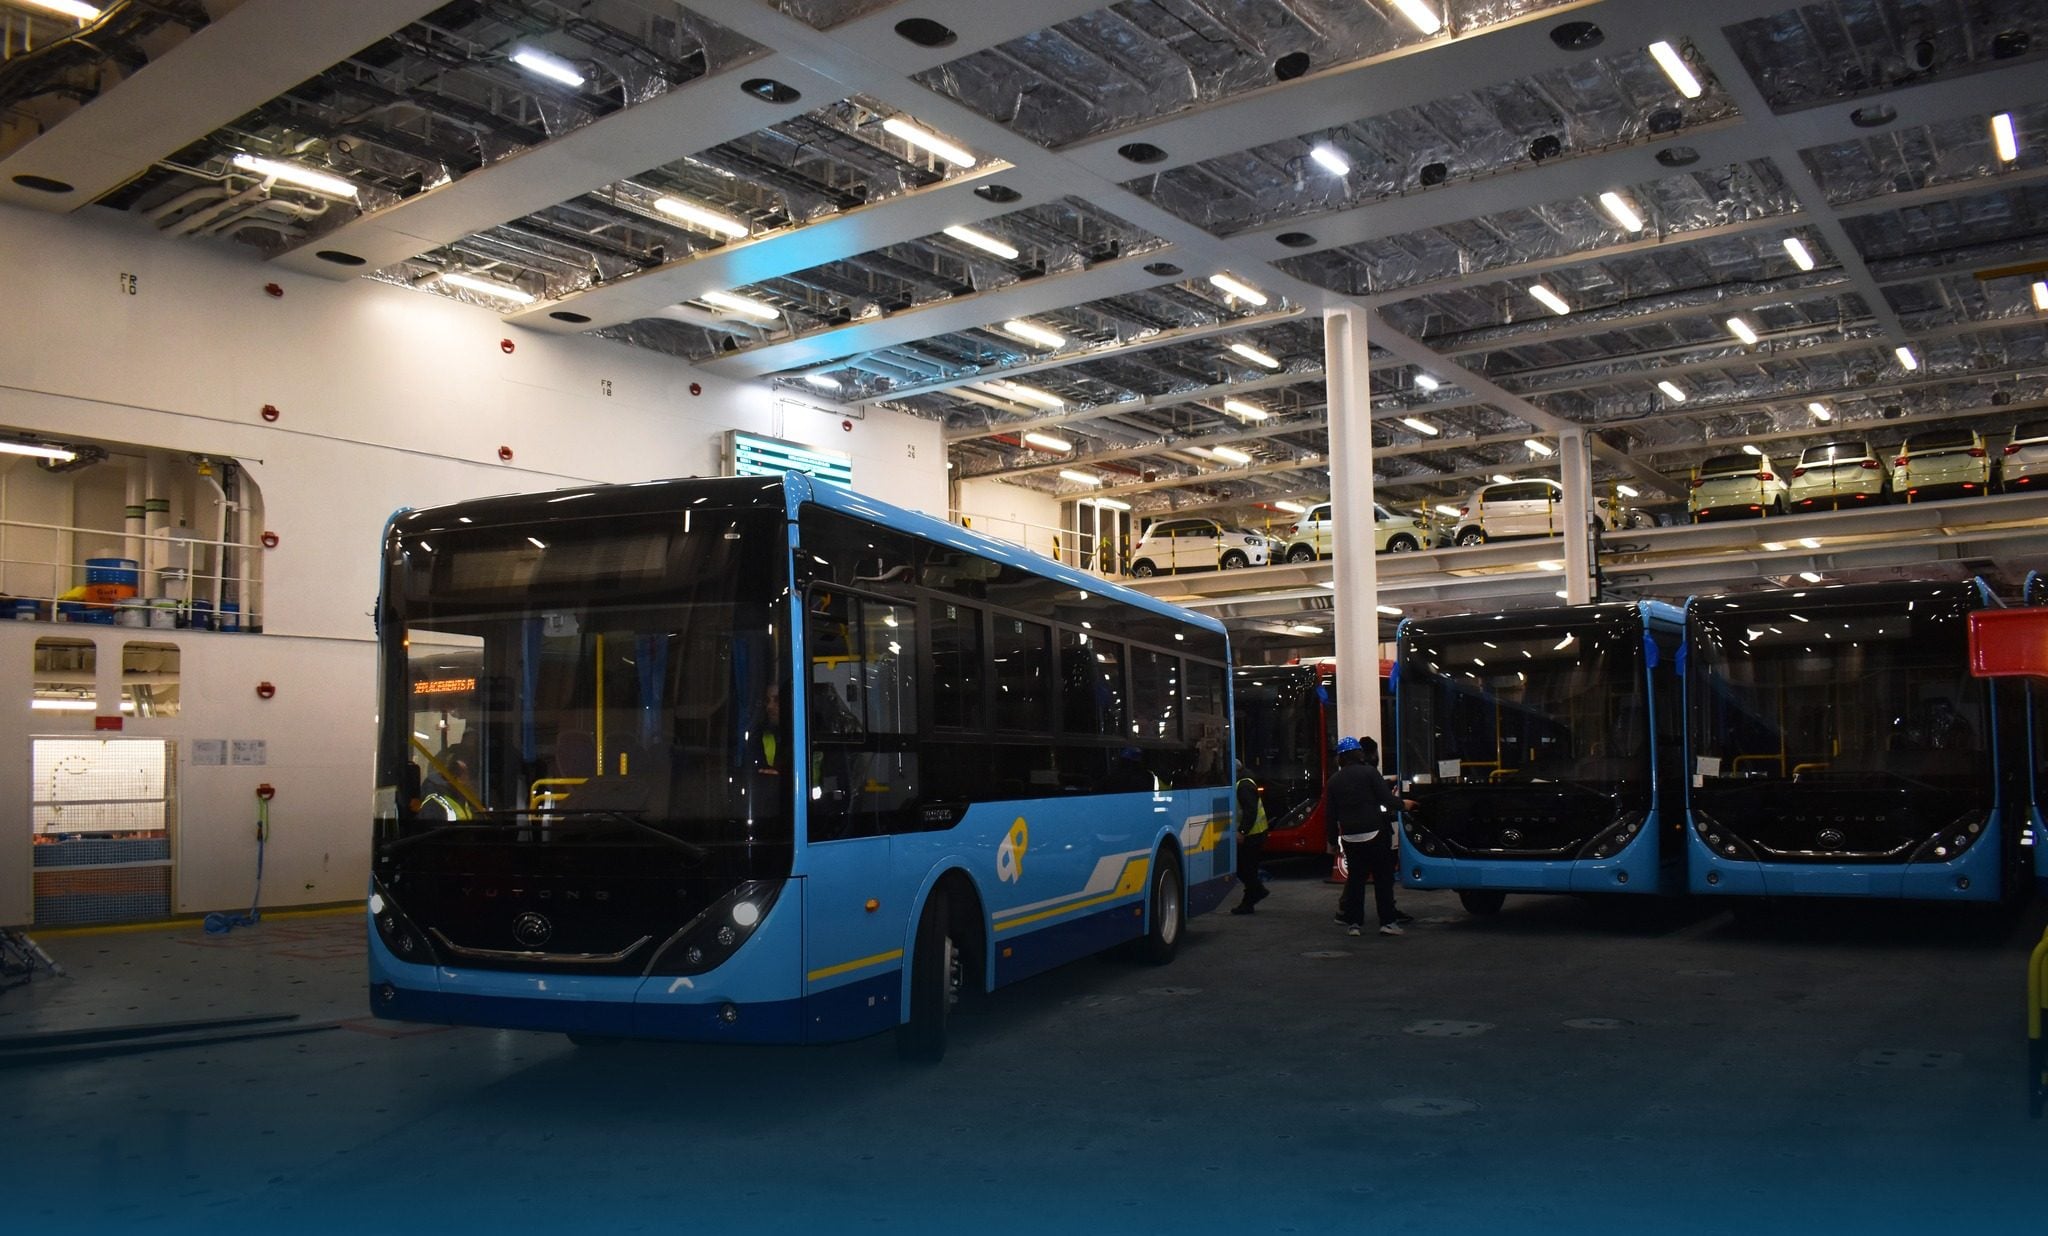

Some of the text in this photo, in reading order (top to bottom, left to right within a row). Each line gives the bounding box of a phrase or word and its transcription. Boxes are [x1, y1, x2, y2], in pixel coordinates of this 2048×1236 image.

[120, 272, 137, 285] FR
[120, 283, 137, 295] 10
[600, 379, 612, 388] FR
[461, 887, 609, 901] YUTONG
